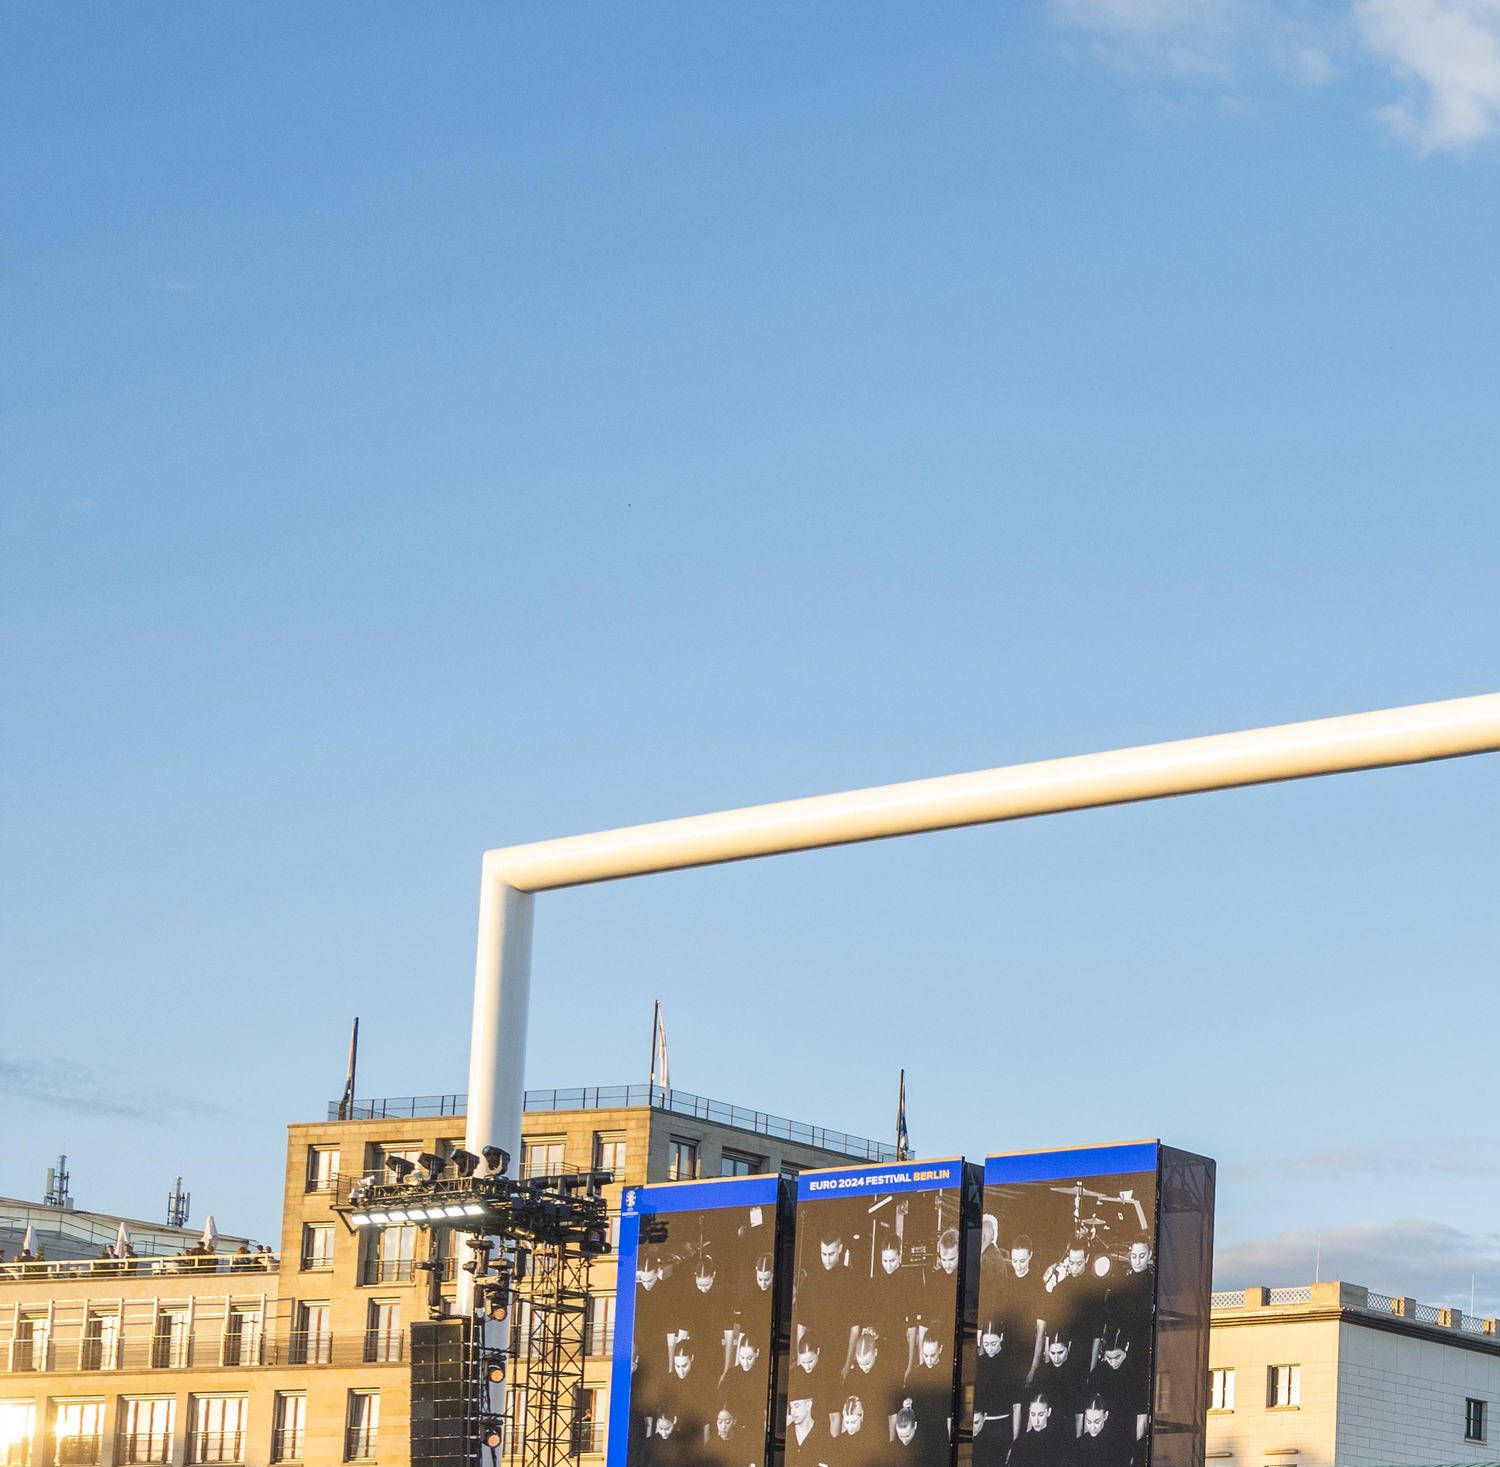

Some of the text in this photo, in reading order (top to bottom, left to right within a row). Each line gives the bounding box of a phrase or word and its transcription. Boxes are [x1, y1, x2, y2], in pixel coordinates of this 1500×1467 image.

[809, 1169, 950, 1191] EURO 2024 FESTIVAL BERLIN
